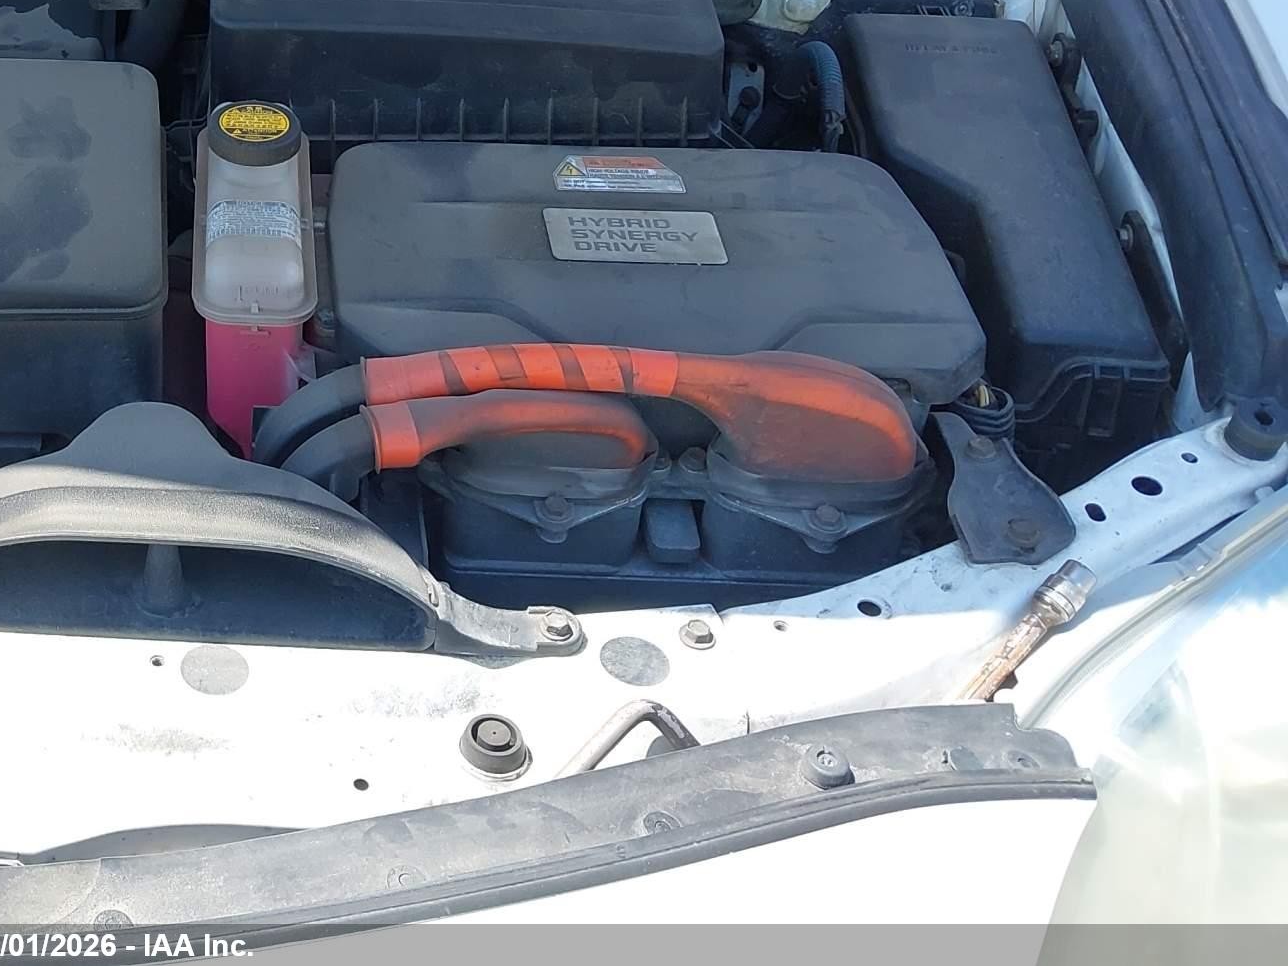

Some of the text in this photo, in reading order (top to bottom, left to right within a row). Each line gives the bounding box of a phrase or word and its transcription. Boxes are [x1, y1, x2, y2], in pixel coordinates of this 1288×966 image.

[568, 216, 671, 229] HYBRID
[571, 229, 698, 242] SYNERGY
[574, 241, 657, 253] DRIVE
